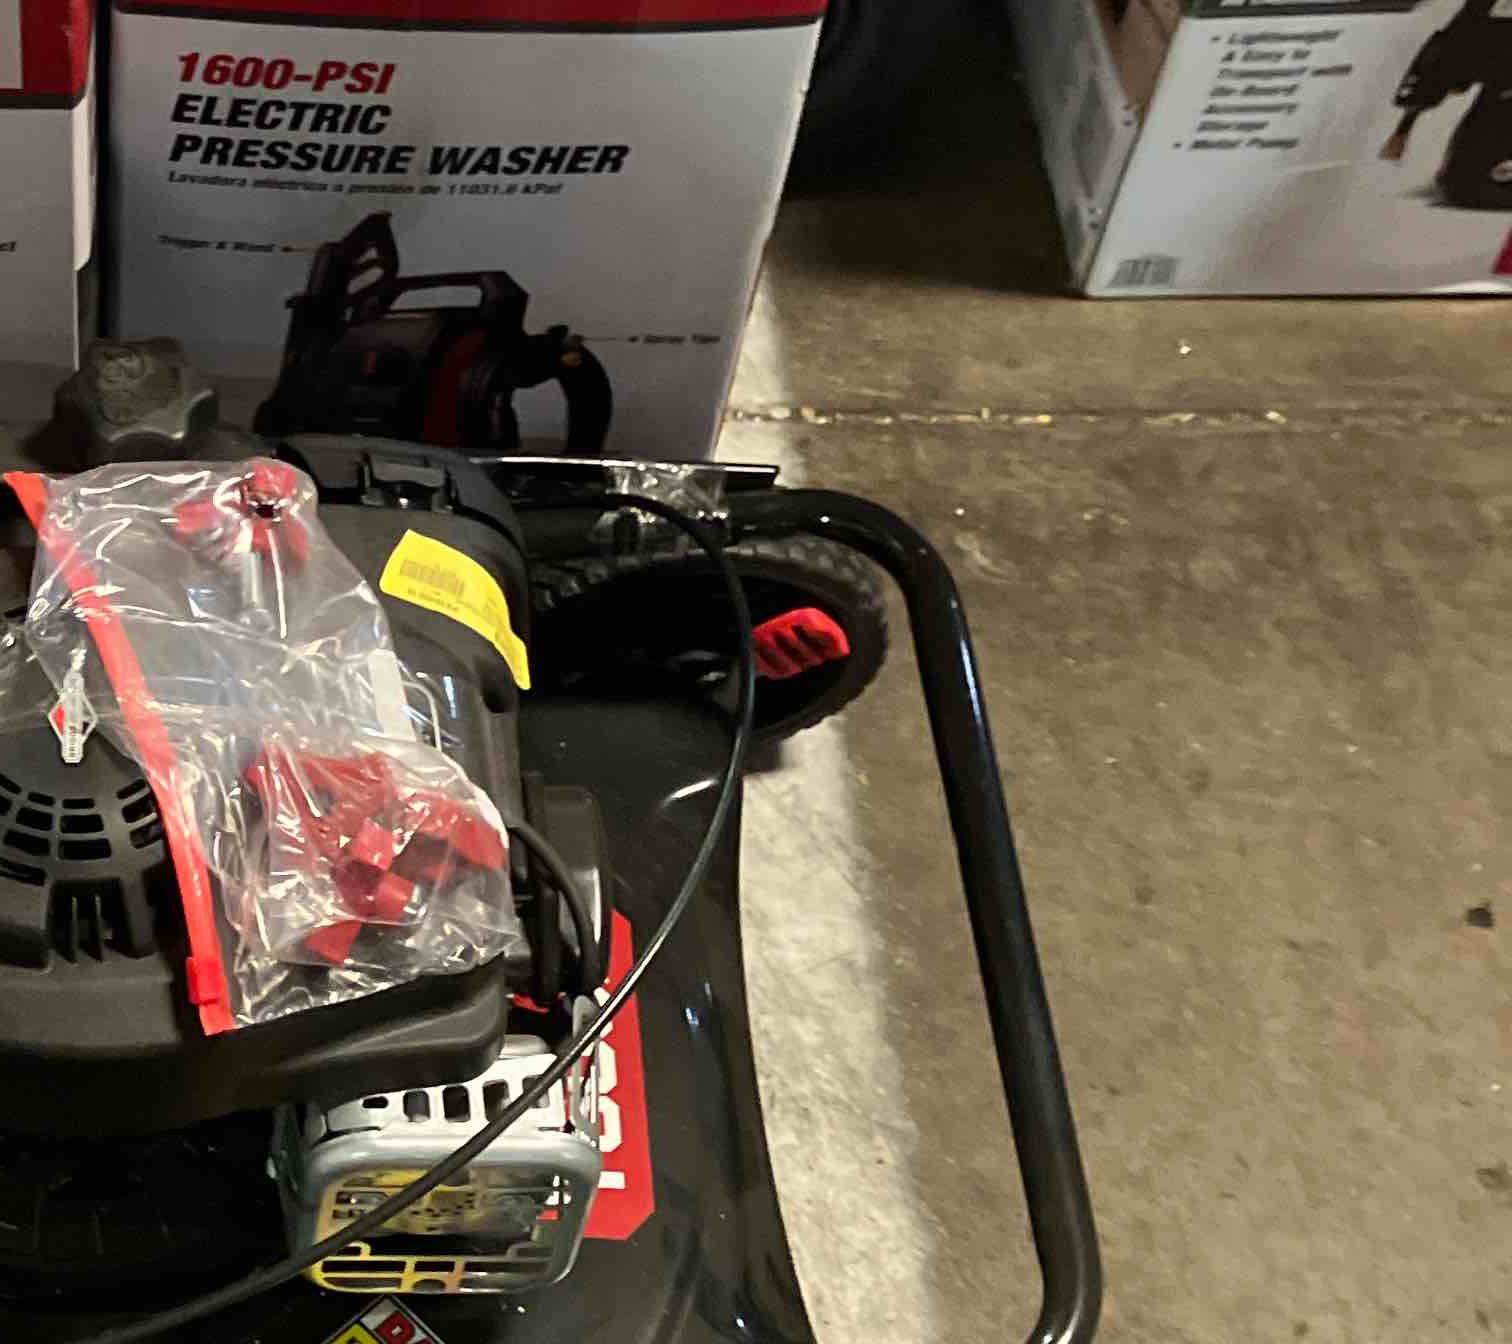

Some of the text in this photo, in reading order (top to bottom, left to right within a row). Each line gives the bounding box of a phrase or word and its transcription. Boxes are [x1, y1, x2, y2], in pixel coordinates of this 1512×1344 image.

[177, 51, 397, 96] 1600-PSI
[170, 93, 393, 136] ELECTRIC
[168, 133, 630, 178] PRESSURE WASHER
